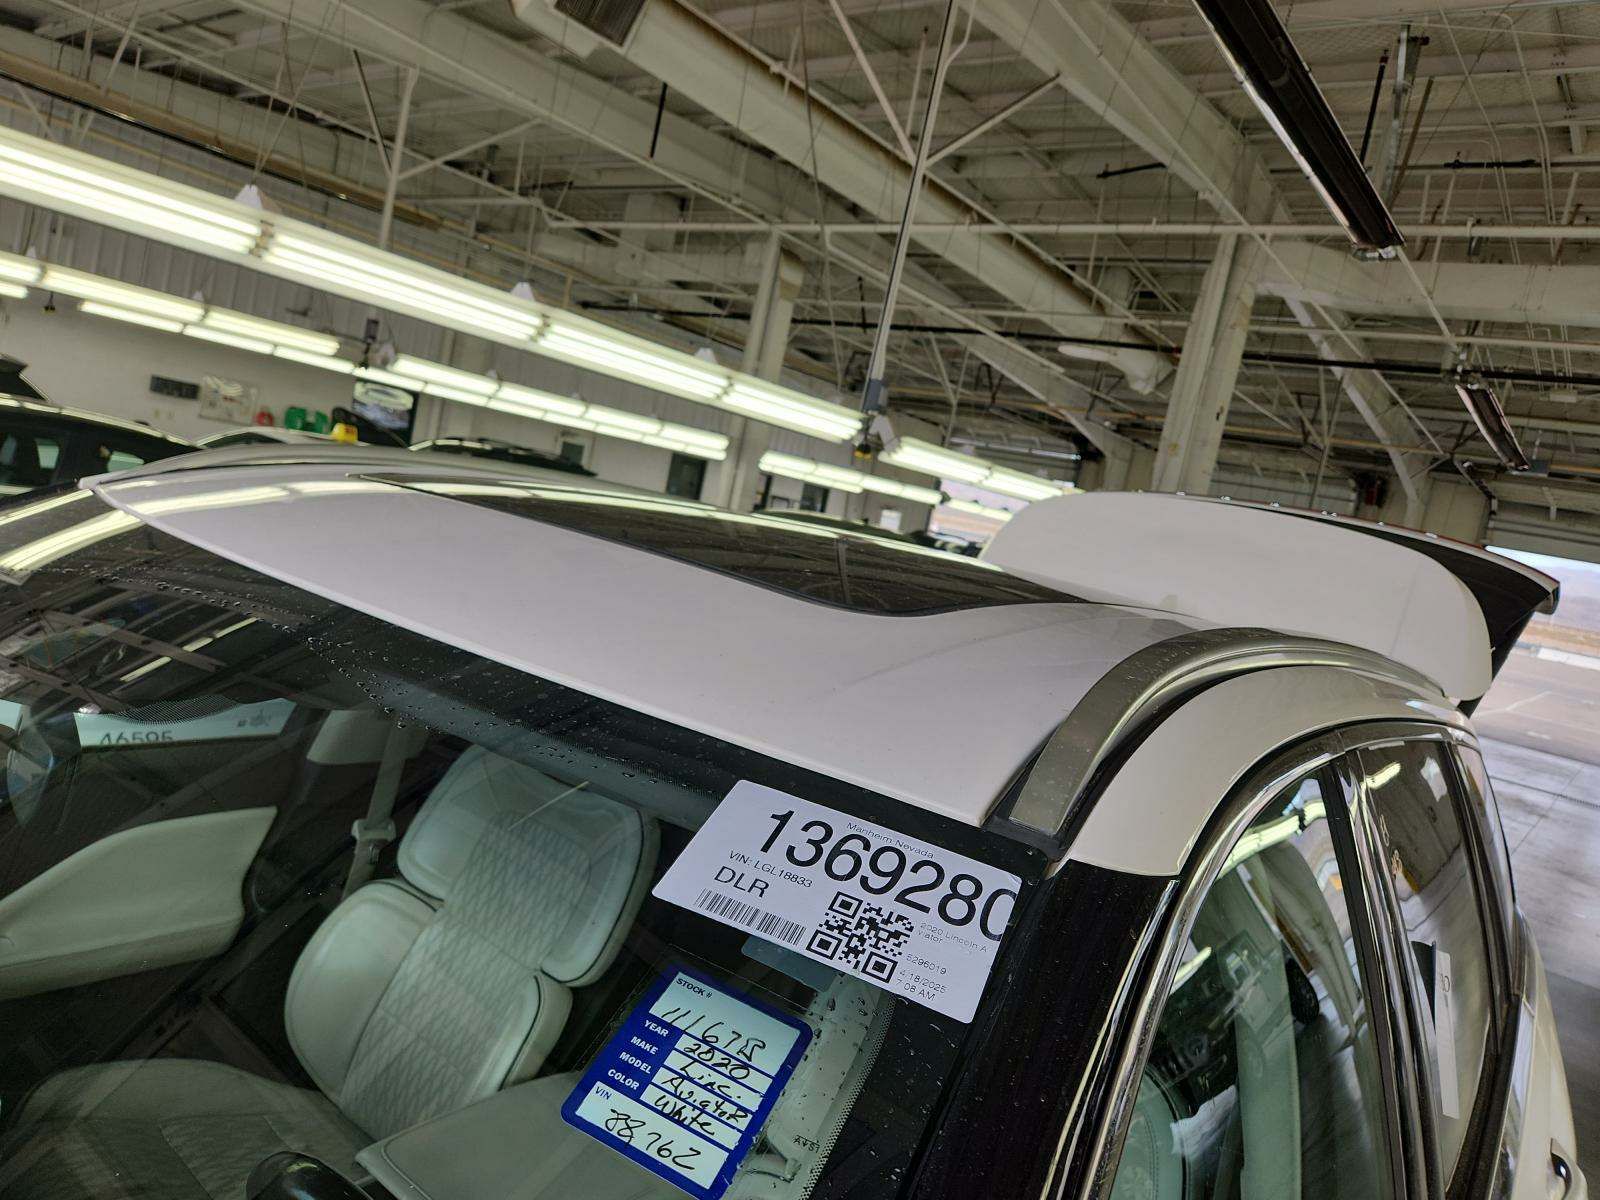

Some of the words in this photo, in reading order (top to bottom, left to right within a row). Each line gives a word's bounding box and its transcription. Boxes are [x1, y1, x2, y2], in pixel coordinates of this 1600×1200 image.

[846, 822, 893, 845] Manheim
[894, 838, 935, 860] Nevada
[729, 850, 751, 866] VIN:
[753, 861, 813, 889] LGL18833
[760, 810, 1018, 942] 1369280
[714, 865, 770, 898] DLR
[920, 922, 944, 936] 2020
[906, 953, 947, 975] 5296019
[676, 978, 705, 997] STOCK
[706, 991, 713, 999] #
[918, 989, 936, 1001] AM
[644, 1020, 669, 1037] YEAR
[630, 1036, 659, 1055] MAKE
[619, 1051, 652, 1074] MODEL
[683, 1043, 750, 1080] 2020
[607, 1068, 640, 1091] COLOR
[595, 1086, 613, 1100] VIN
